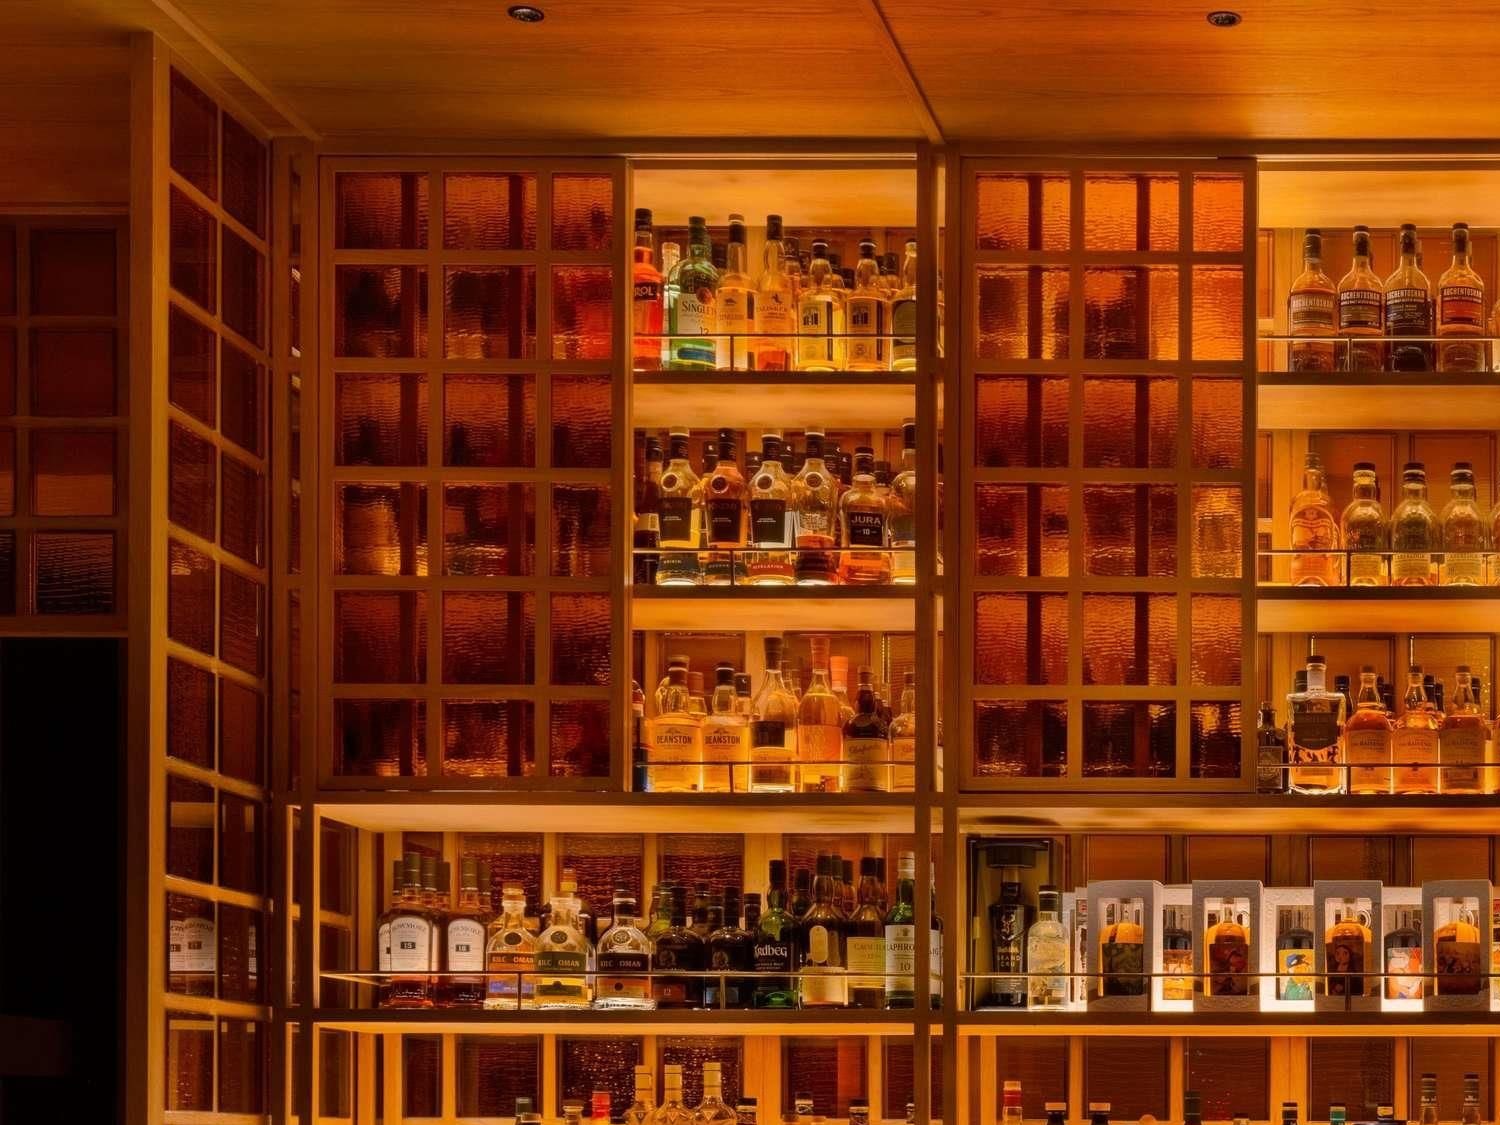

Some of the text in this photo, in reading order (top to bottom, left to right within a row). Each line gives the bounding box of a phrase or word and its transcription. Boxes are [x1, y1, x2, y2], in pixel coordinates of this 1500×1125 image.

[1340, 290, 1380, 301] AUCHENTOSHAN
[1387, 288, 1425, 300] AUCHENTOSHAN
[1443, 287, 1482, 298] AUCHENTOSHAN
[851, 515, 881, 525] JURA
[656, 735, 692, 745] DEANSTON
[705, 735, 740, 745] DEANSTON
[899, 963, 911, 971] 10
